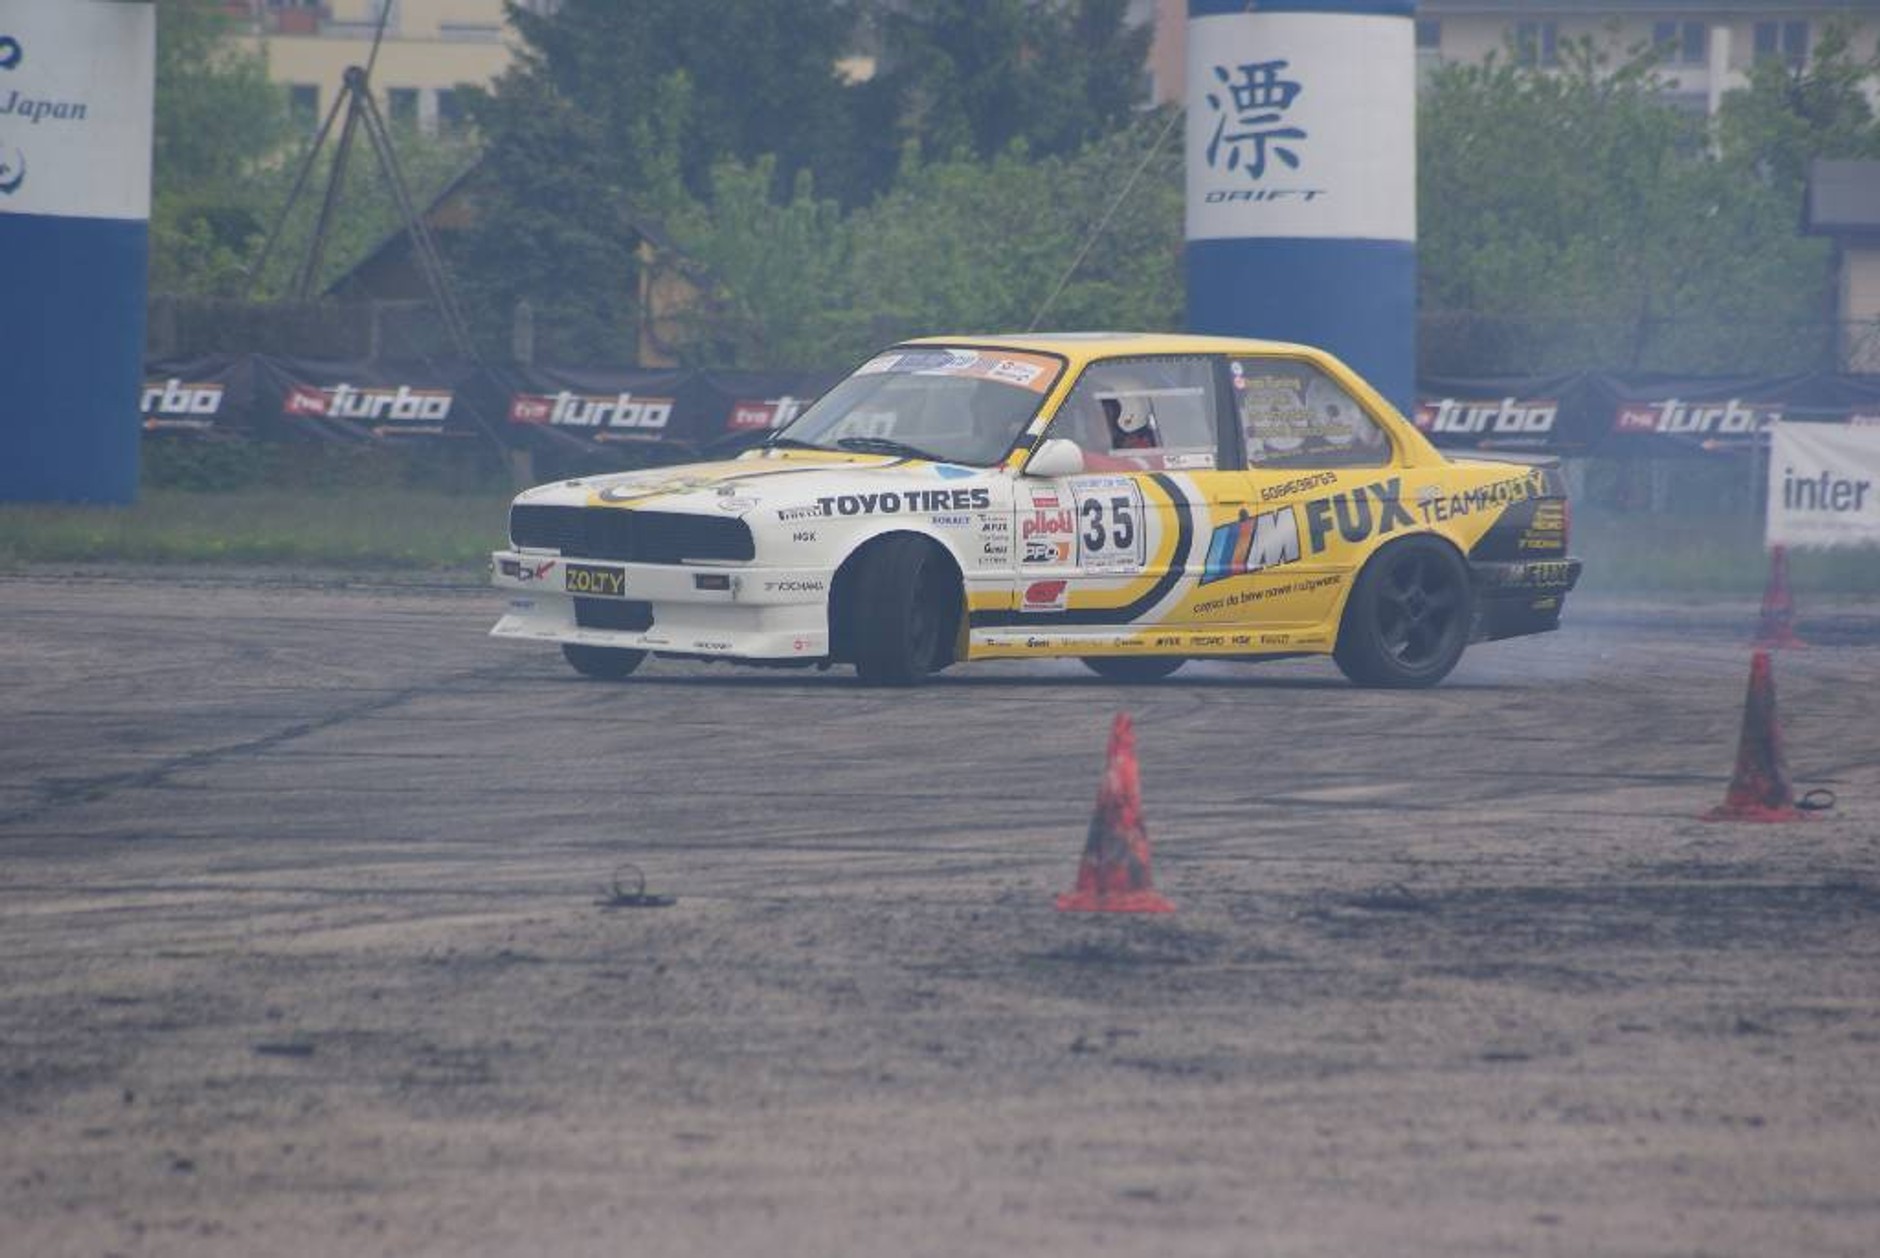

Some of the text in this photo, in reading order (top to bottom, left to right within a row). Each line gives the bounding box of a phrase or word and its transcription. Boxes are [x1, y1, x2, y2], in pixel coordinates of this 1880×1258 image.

[0, 91, 88, 124] Japan
[1206, 60, 1307, 180] 漂
[1205, 189, 1326, 203] DRIFT
[817, 488, 989, 516] TOYO TIRES
[1784, 467, 1870, 511] inter
[1081, 496, 1134, 551] 35
[1304, 477, 1416, 554] FUX
[567, 569, 623, 593] ZOLTY
